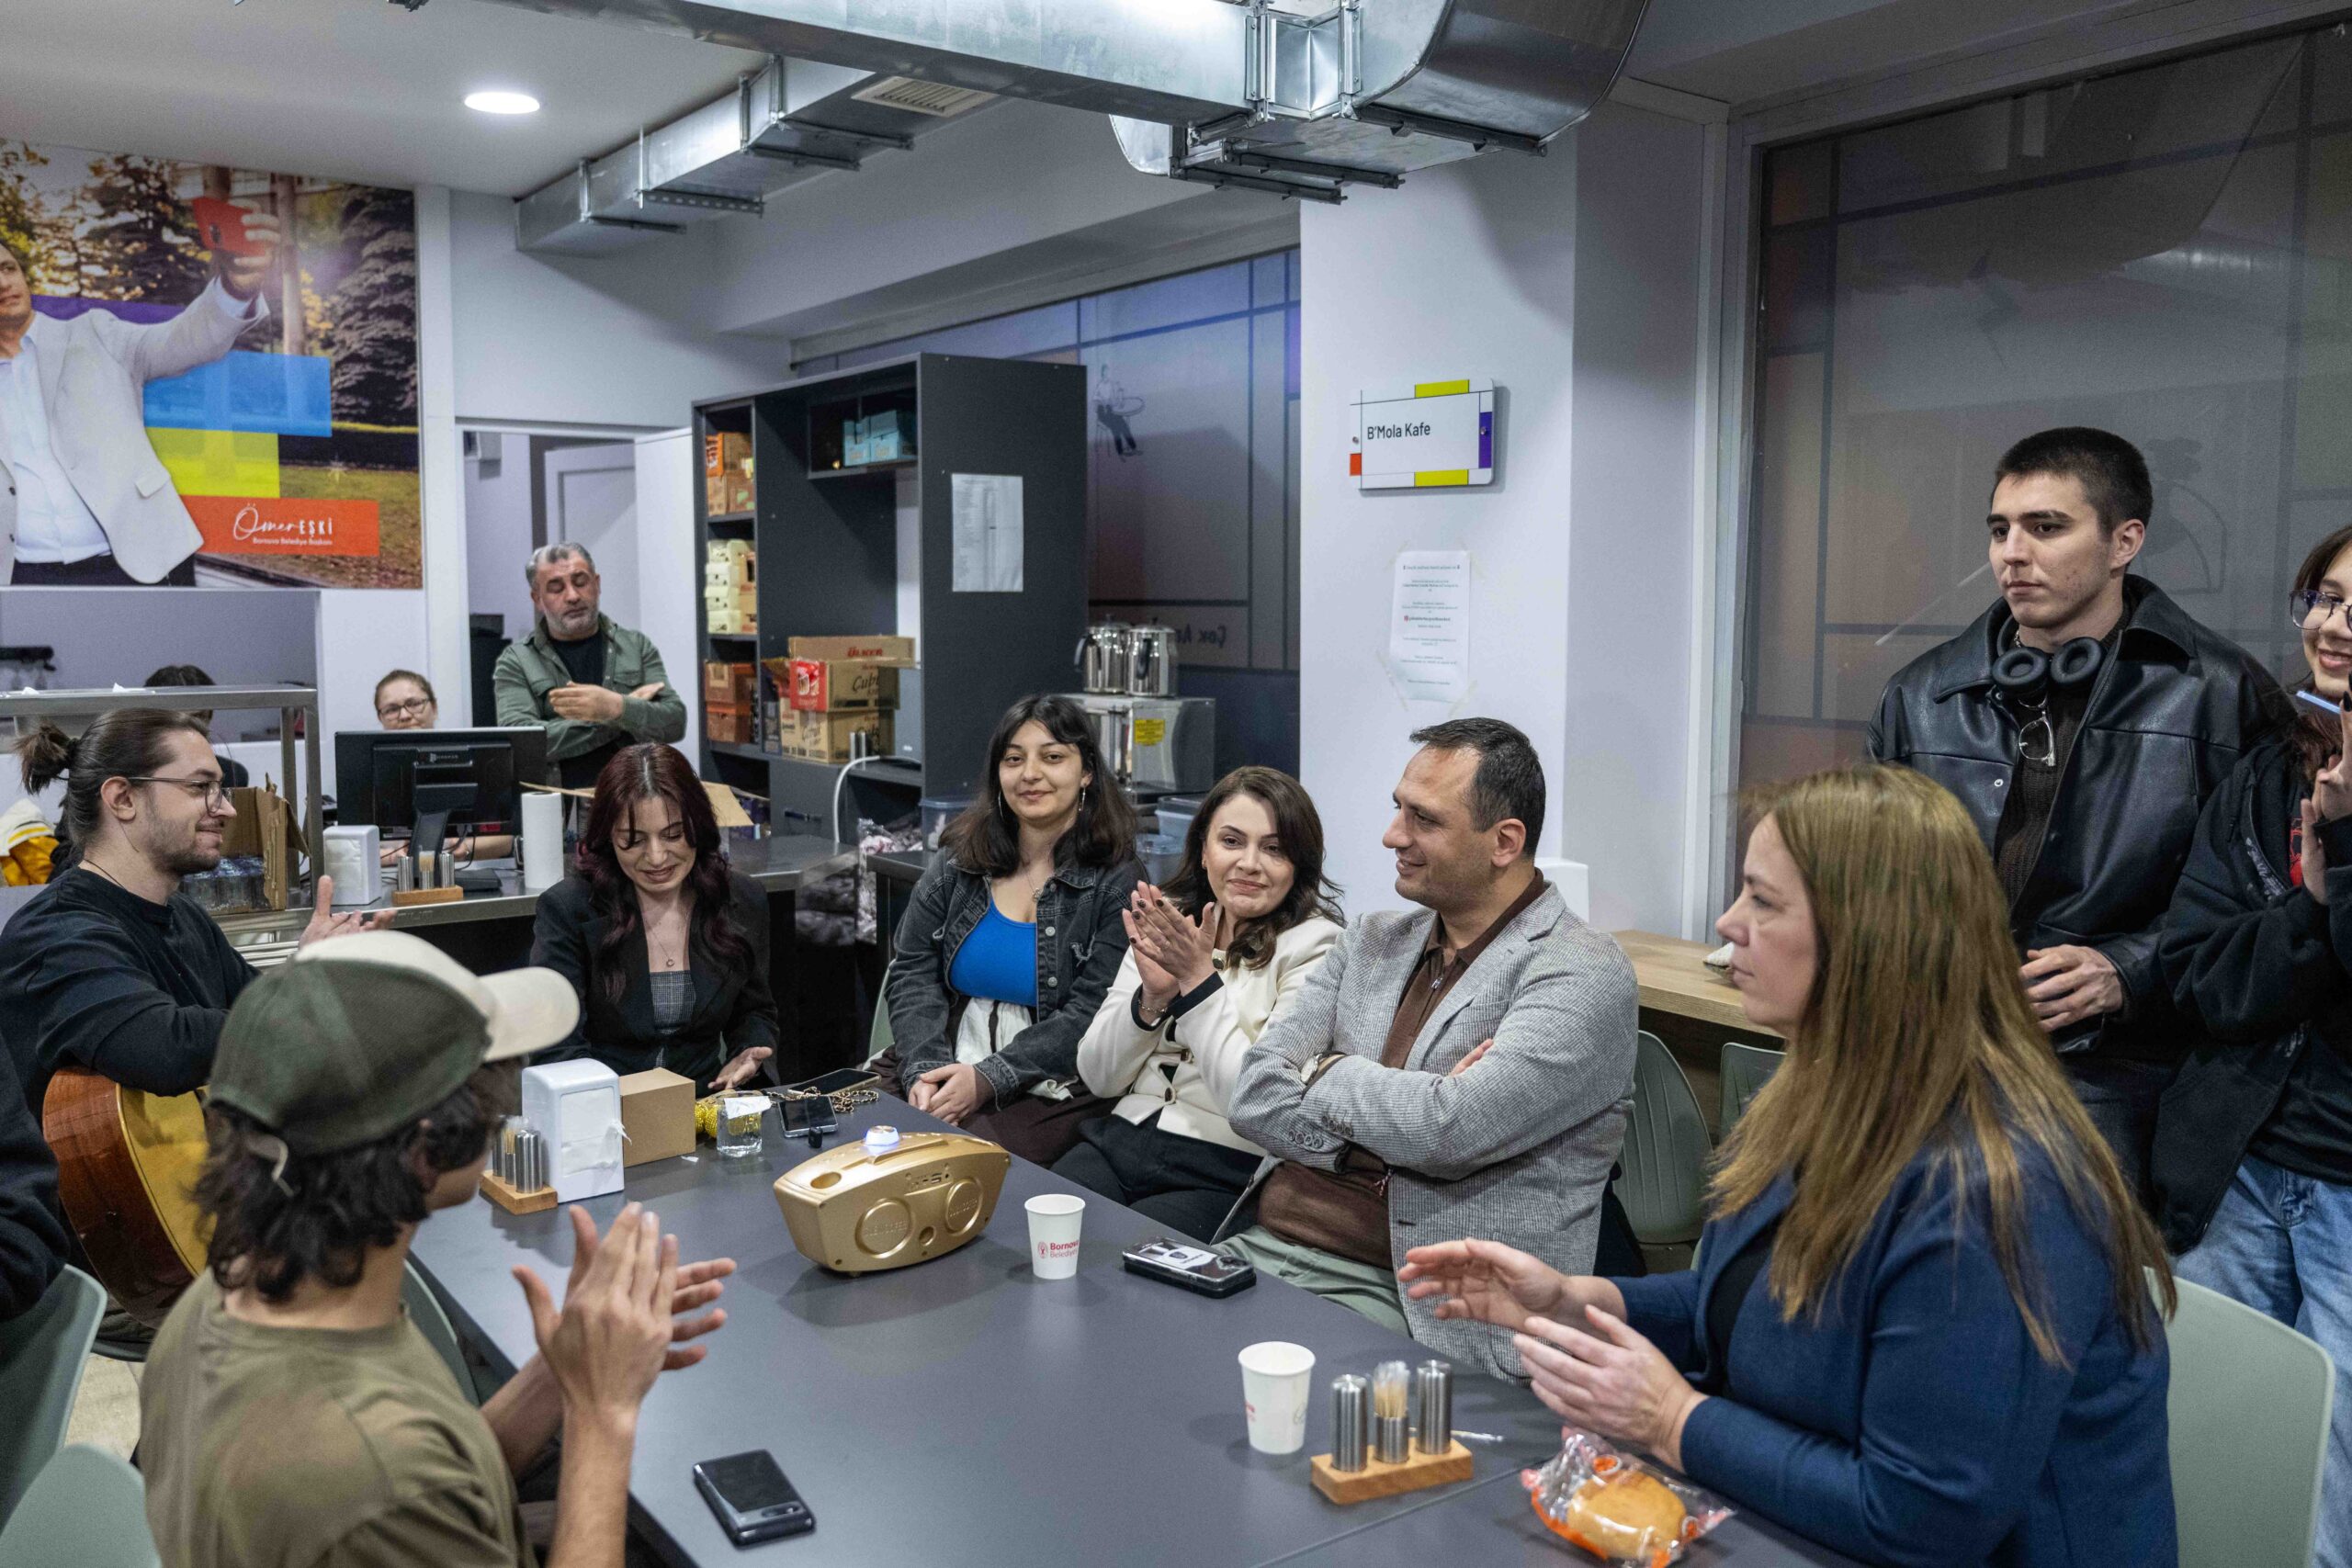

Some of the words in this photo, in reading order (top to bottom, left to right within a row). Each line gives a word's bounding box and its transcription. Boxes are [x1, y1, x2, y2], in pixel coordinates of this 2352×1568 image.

[1367, 424, 1402, 440] B'Mola
[1405, 422, 1430, 437] Kafe
[233, 502, 299, 540] Ömer
[300, 517, 333, 538] EŞKİ
